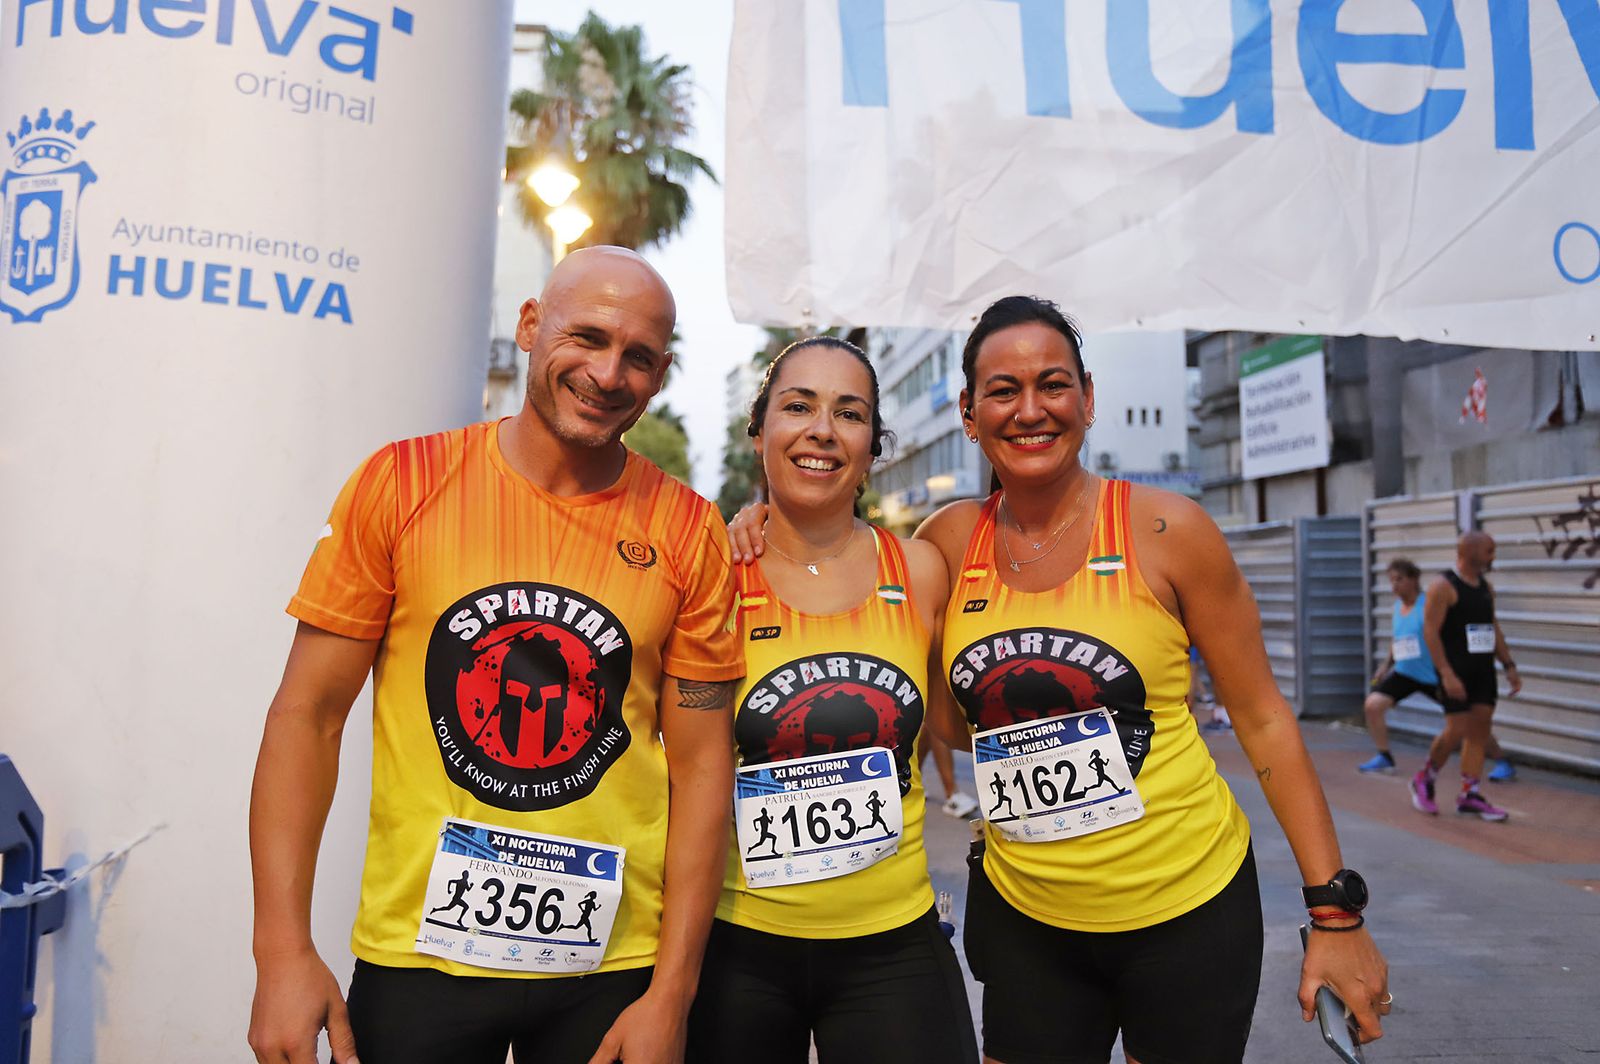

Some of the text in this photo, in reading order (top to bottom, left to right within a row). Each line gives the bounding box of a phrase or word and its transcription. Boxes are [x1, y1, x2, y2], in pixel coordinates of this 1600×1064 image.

[840, 0, 1600, 151] uel
[235, 70, 375, 125] original
[112, 217, 360, 272] Ayuntamiento de
[107, 255, 353, 324] HUELVA
[448, 589, 624, 656] SPARTAN
[952, 632, 1129, 689] SPARTAN
[747, 656, 918, 714] SPARTAN
[1000, 721, 1066, 745] XI NOCTURNA
[1008, 737, 1062, 756] DE HUELVA
[1127, 729, 1147, 758] LINE
[436, 716, 623, 798] YOU'LL KNOW AT THE FINISH LINE
[774, 760, 850, 779] XI NOCTURNA
[765, 791, 811, 805] PATRICIA
[784, 774, 844, 790] DE HUELVA
[1013, 760, 1085, 810] 162
[782, 798, 857, 848] 163
[491, 834, 577, 858] XI NOCTURNA
[498, 851, 566, 873] DE HUELVA
[469, 859, 534, 881] FERNANDO
[751, 869, 775, 880] Huelva
[474, 877, 565, 935] 356
[424, 933, 453, 949] Huelva
